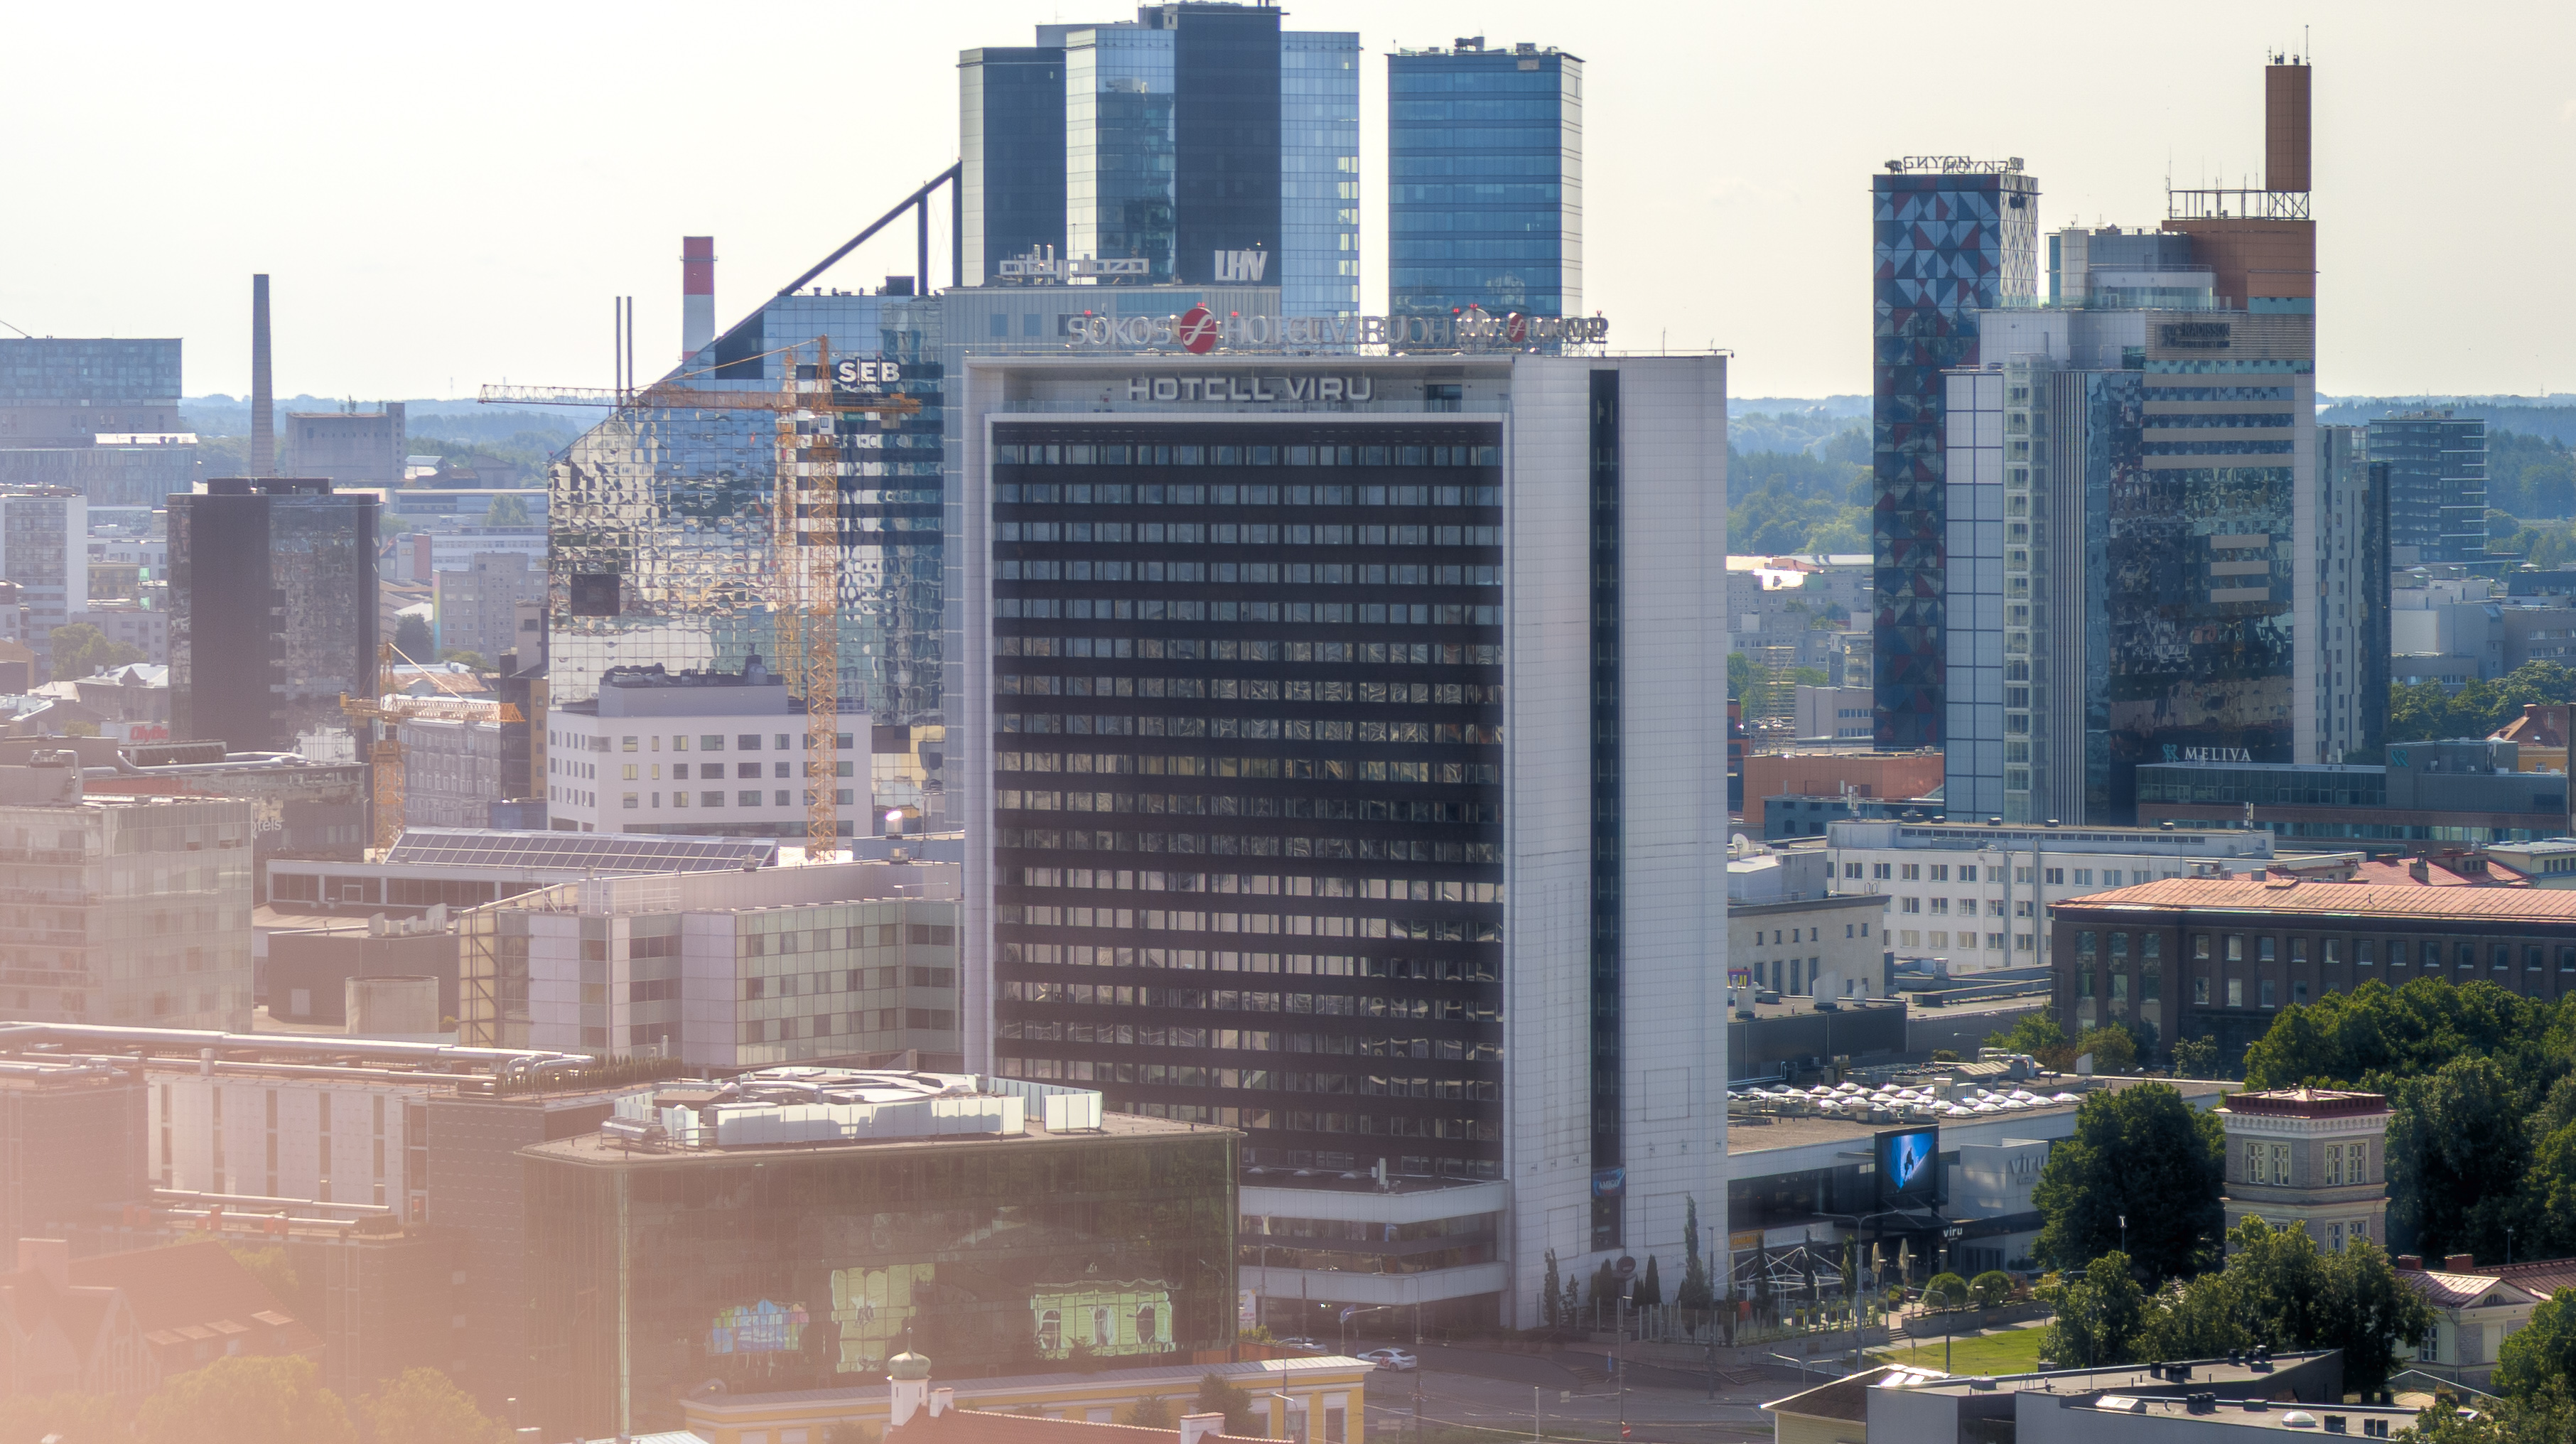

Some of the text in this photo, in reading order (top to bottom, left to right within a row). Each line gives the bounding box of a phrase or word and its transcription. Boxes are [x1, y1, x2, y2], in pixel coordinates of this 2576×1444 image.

[1067, 316, 1173, 346] SOKOS
[839, 361, 900, 382] SEB
[1286, 377, 1371, 401] VIRU
[2184, 747, 2252, 762] MELIVA
[1598, 1180, 1620, 1190] AMIGO
[1944, 1227, 1963, 1237] viru
